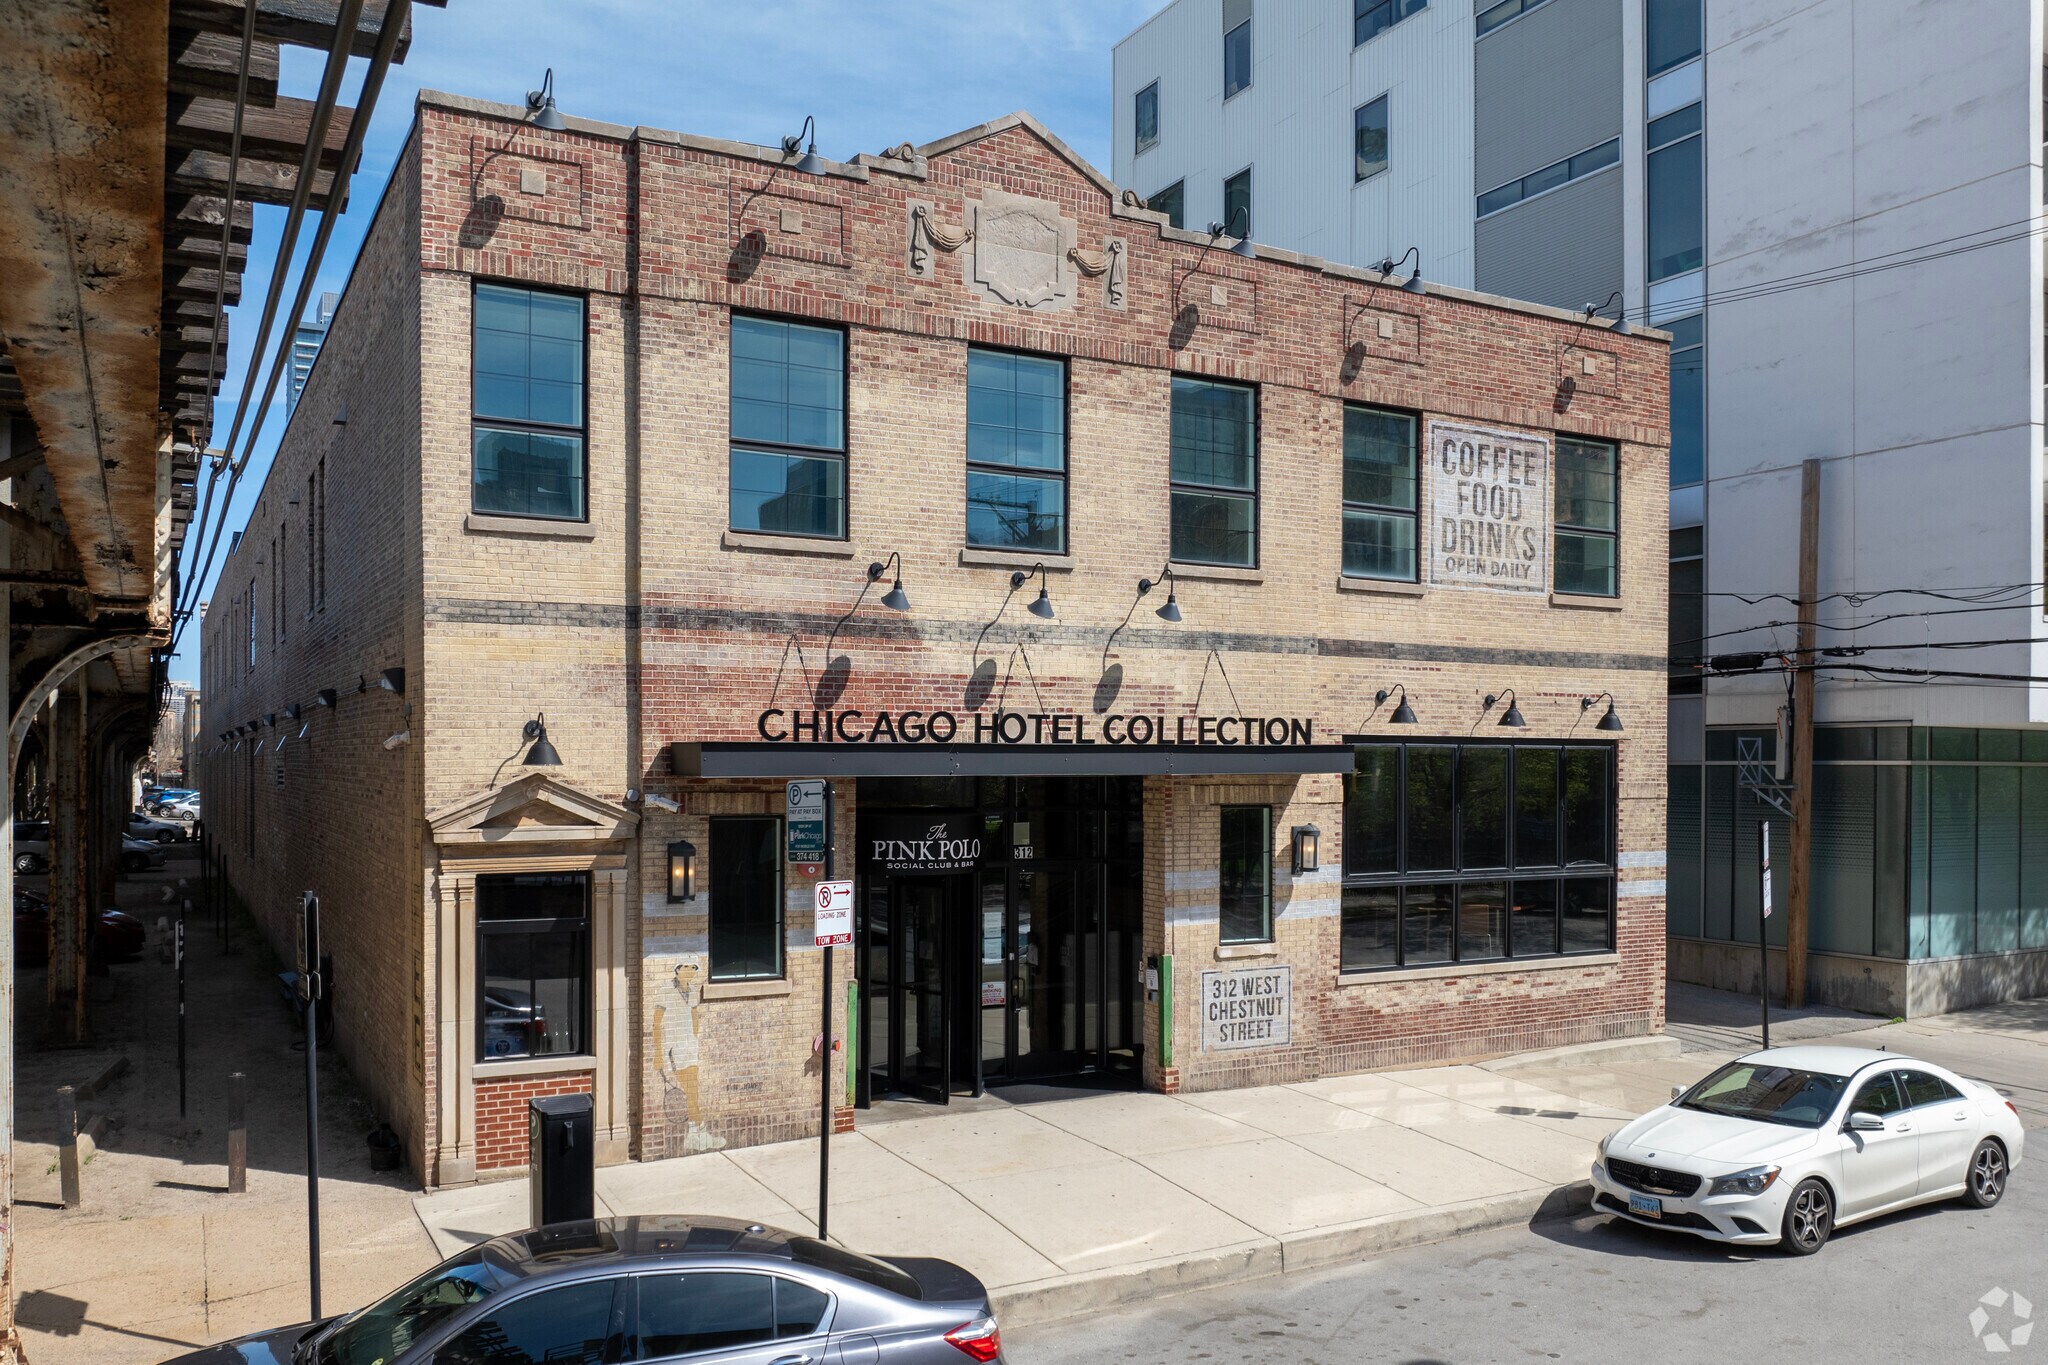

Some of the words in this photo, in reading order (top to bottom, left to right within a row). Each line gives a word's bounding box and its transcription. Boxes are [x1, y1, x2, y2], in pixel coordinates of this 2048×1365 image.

[1442, 439, 1537, 487] COFFEE
[1457, 480, 1522, 522] FOOD
[1442, 517, 1536, 561] DRINKS
[1445, 556, 1486, 575] OPEN
[1491, 561, 1532, 579] DAILY
[758, 709, 957, 743] CHICAGO
[975, 713, 1095, 744] HOTEL
[1103, 715, 1312, 745] COLLECTION
[926, 823, 947, 840] The
[872, 840, 936, 860] PINK
[938, 838, 981, 860] POLO
[1014, 847, 1033, 858] 312
[818, 912, 835, 920] LOADING
[817, 936, 831, 945] TOW
[832, 934, 849, 944] ZONE
[1212, 979, 1237, 998] 312
[1241, 975, 1281, 996] WEST
[1209, 997, 1284, 1021] CHESTNUT
[1220, 1019, 1274, 1042] STREET
